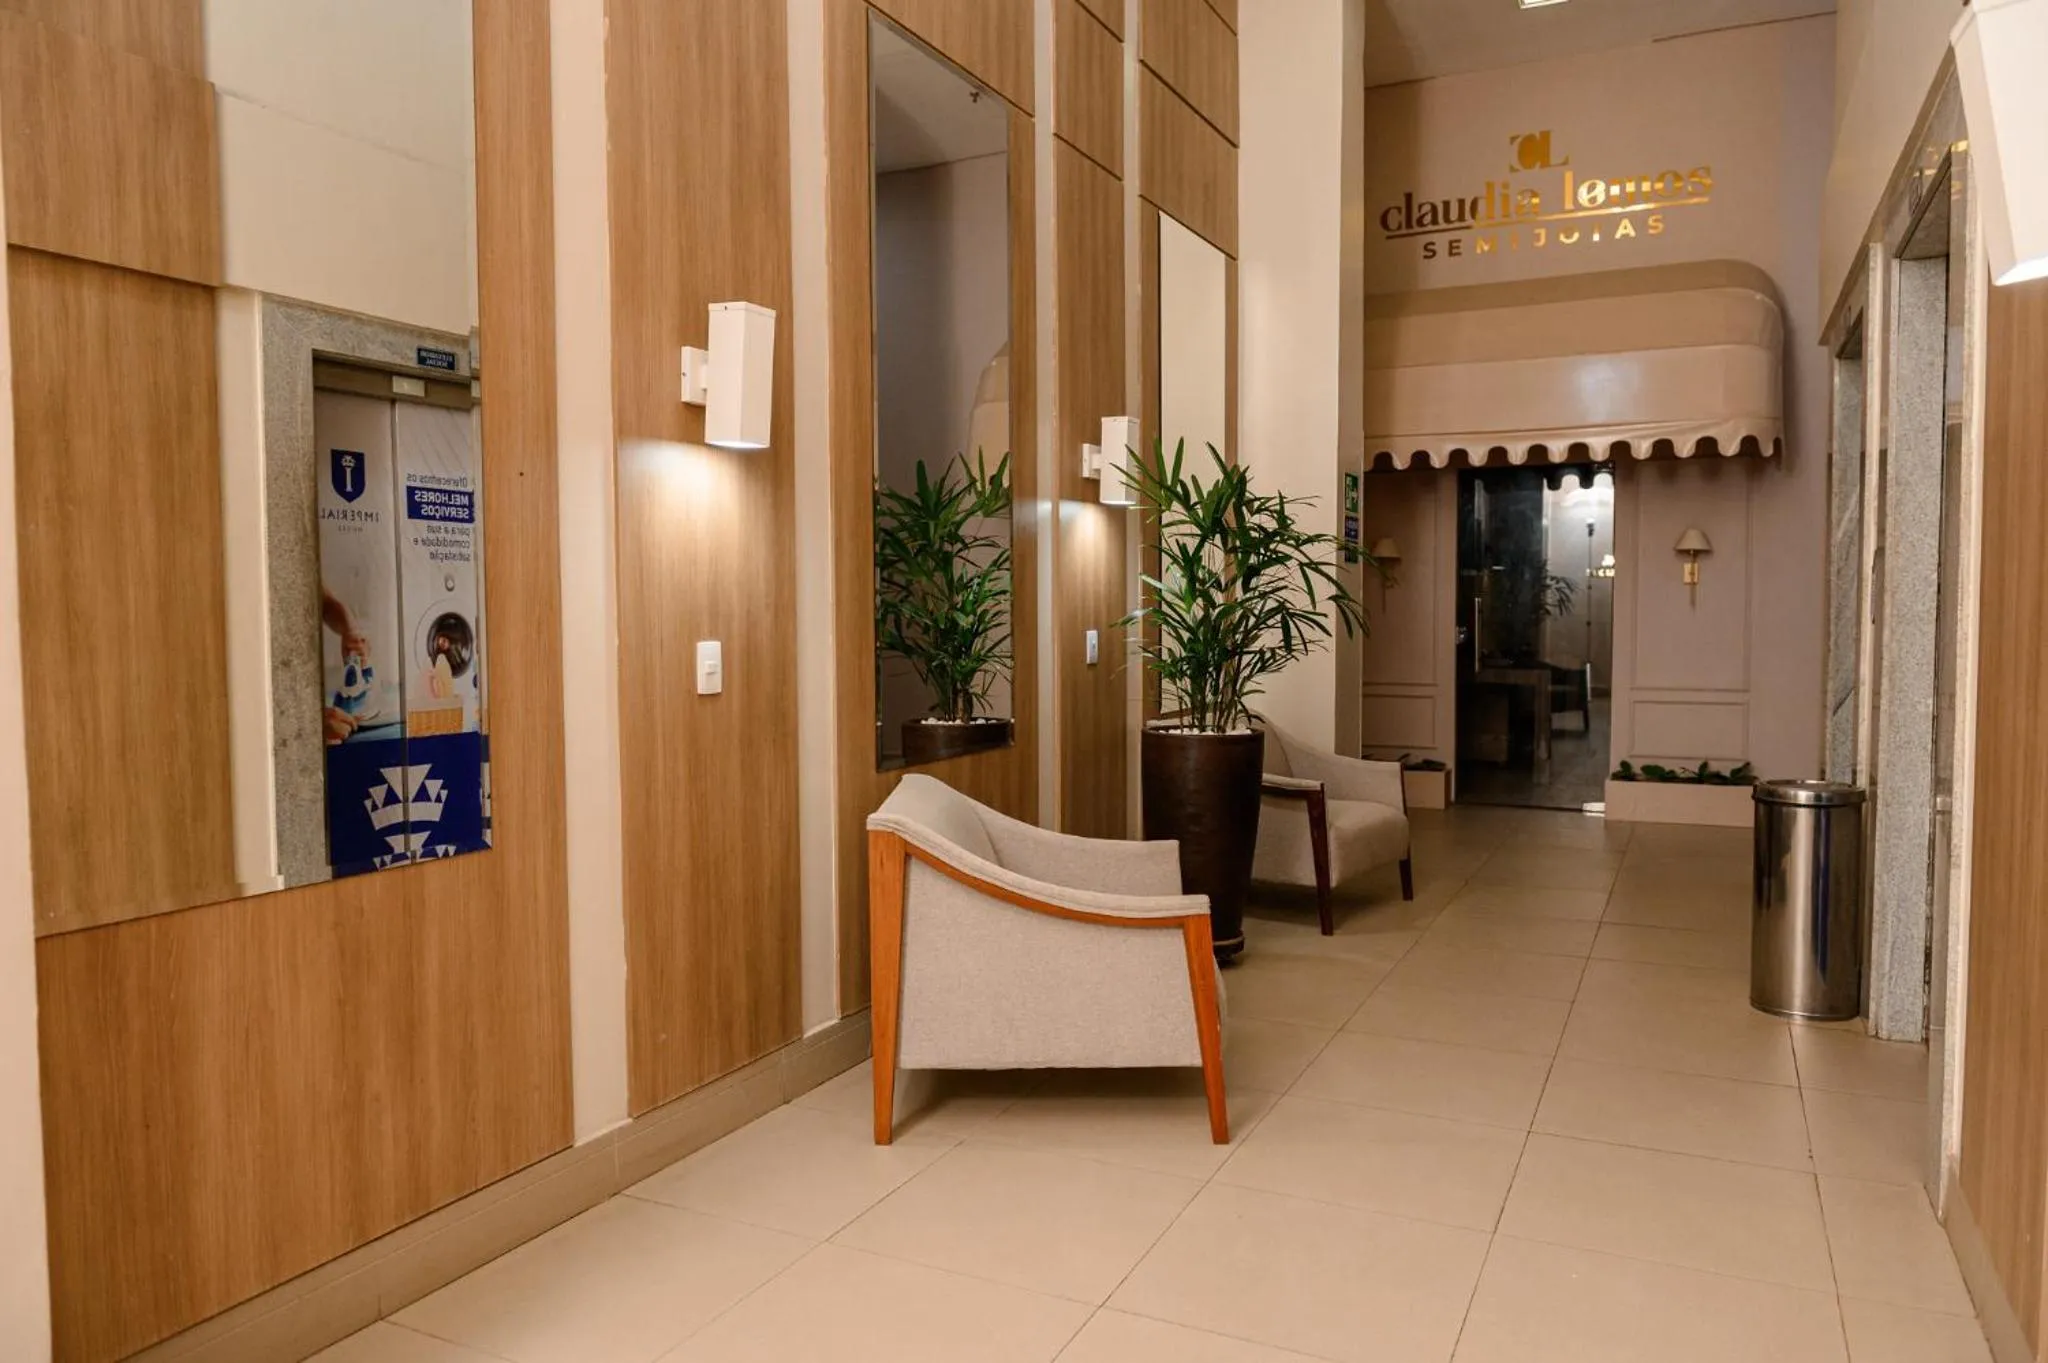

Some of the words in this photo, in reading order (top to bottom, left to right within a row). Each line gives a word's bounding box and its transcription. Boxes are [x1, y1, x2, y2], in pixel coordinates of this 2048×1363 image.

[1379, 181, 1540, 232] claudia
[1564, 166, 1713, 211] lemos
[1423, 214, 1665, 260] SEMIJOIAS
